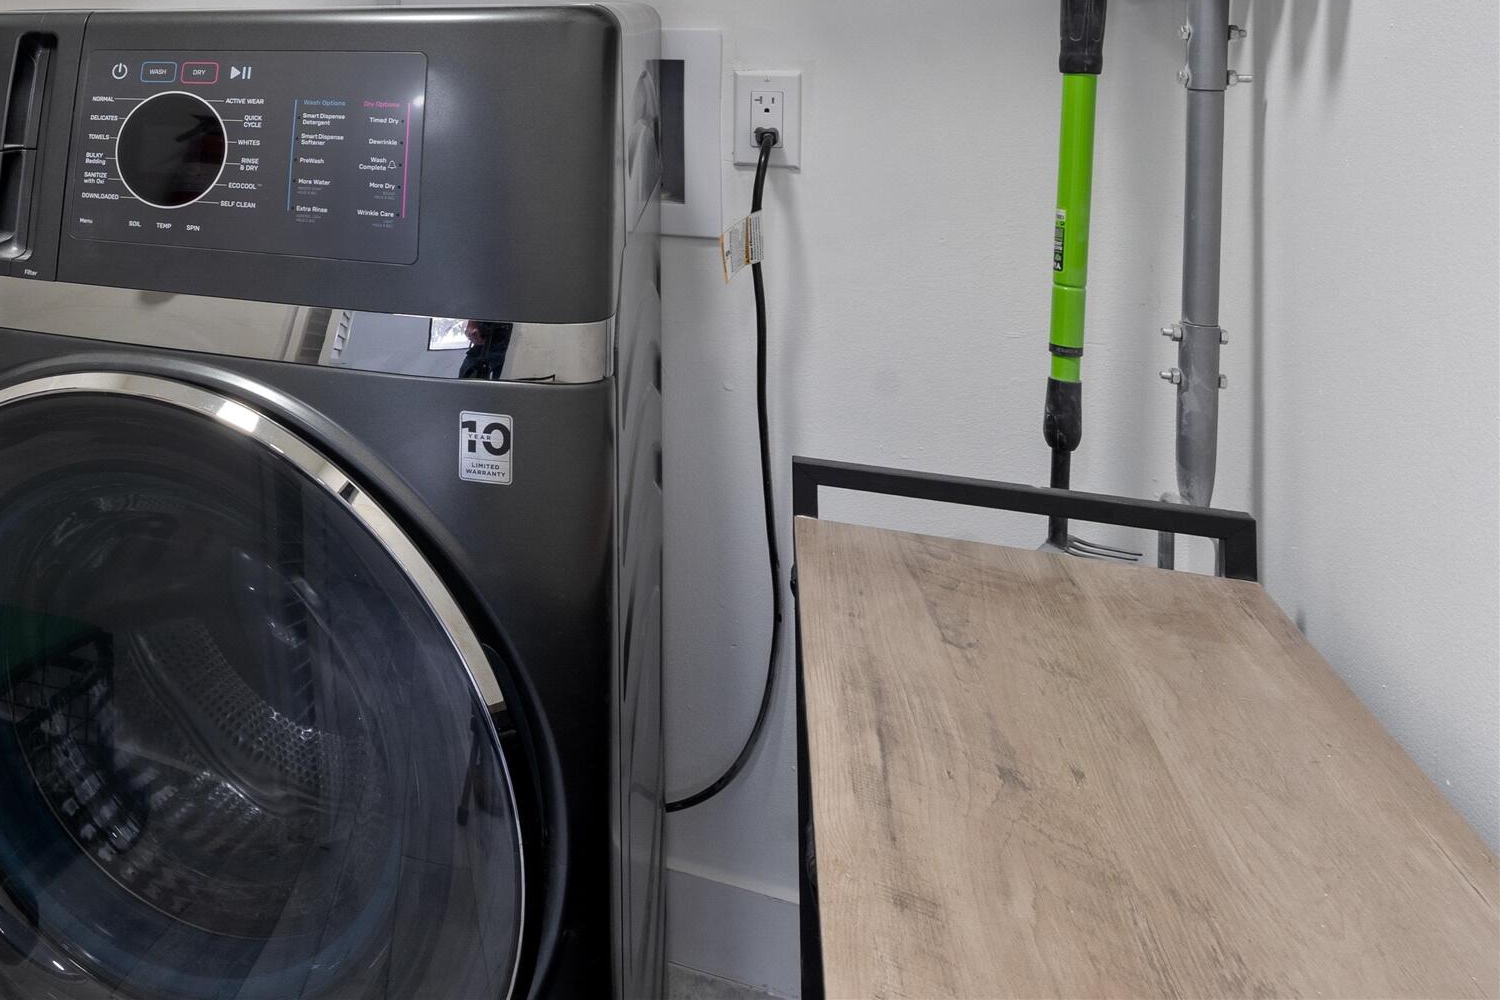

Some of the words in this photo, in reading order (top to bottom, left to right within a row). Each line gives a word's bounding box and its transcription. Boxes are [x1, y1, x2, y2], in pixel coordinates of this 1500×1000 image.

[388, 117, 399, 125] Dry
[368, 138, 398, 146] Dewrinkle
[85, 158, 106, 166] Bedding
[358, 163, 387, 171] Complete
[81, 192, 119, 200] DOWNLOADED
[236, 201, 256, 209] CLEAN
[357, 209, 379, 217] Wrinkle
[379, 210, 394, 218] Care
[24, 268, 38, 276] Filter
[461, 420, 511, 456] 10
[471, 462, 500, 470] LIMITED
[465, 469, 506, 477] WARRANTY
